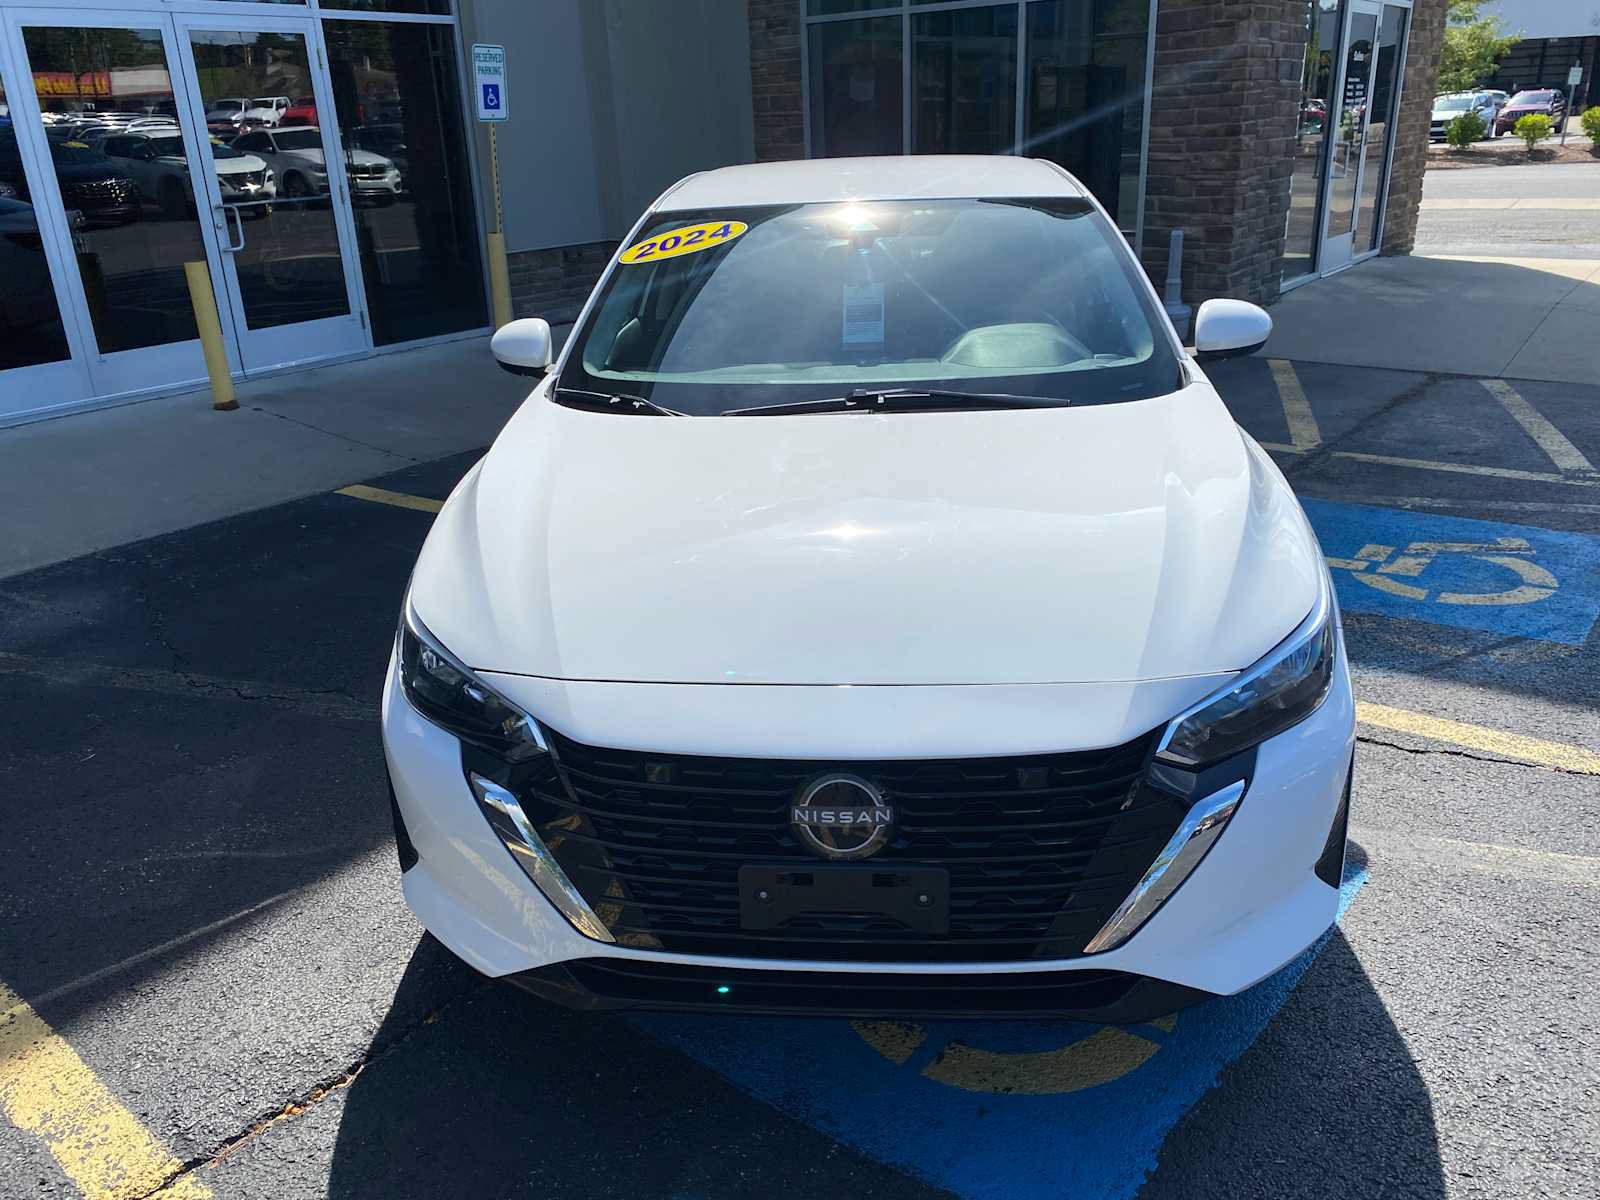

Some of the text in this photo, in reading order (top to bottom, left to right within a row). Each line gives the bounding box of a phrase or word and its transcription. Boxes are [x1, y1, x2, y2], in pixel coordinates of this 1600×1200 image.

[475, 52, 503, 63] RESERVED
[477, 65, 502, 76] PARKING
[633, 224, 732, 260] 2024
[794, 808, 891, 823] NISSAN
